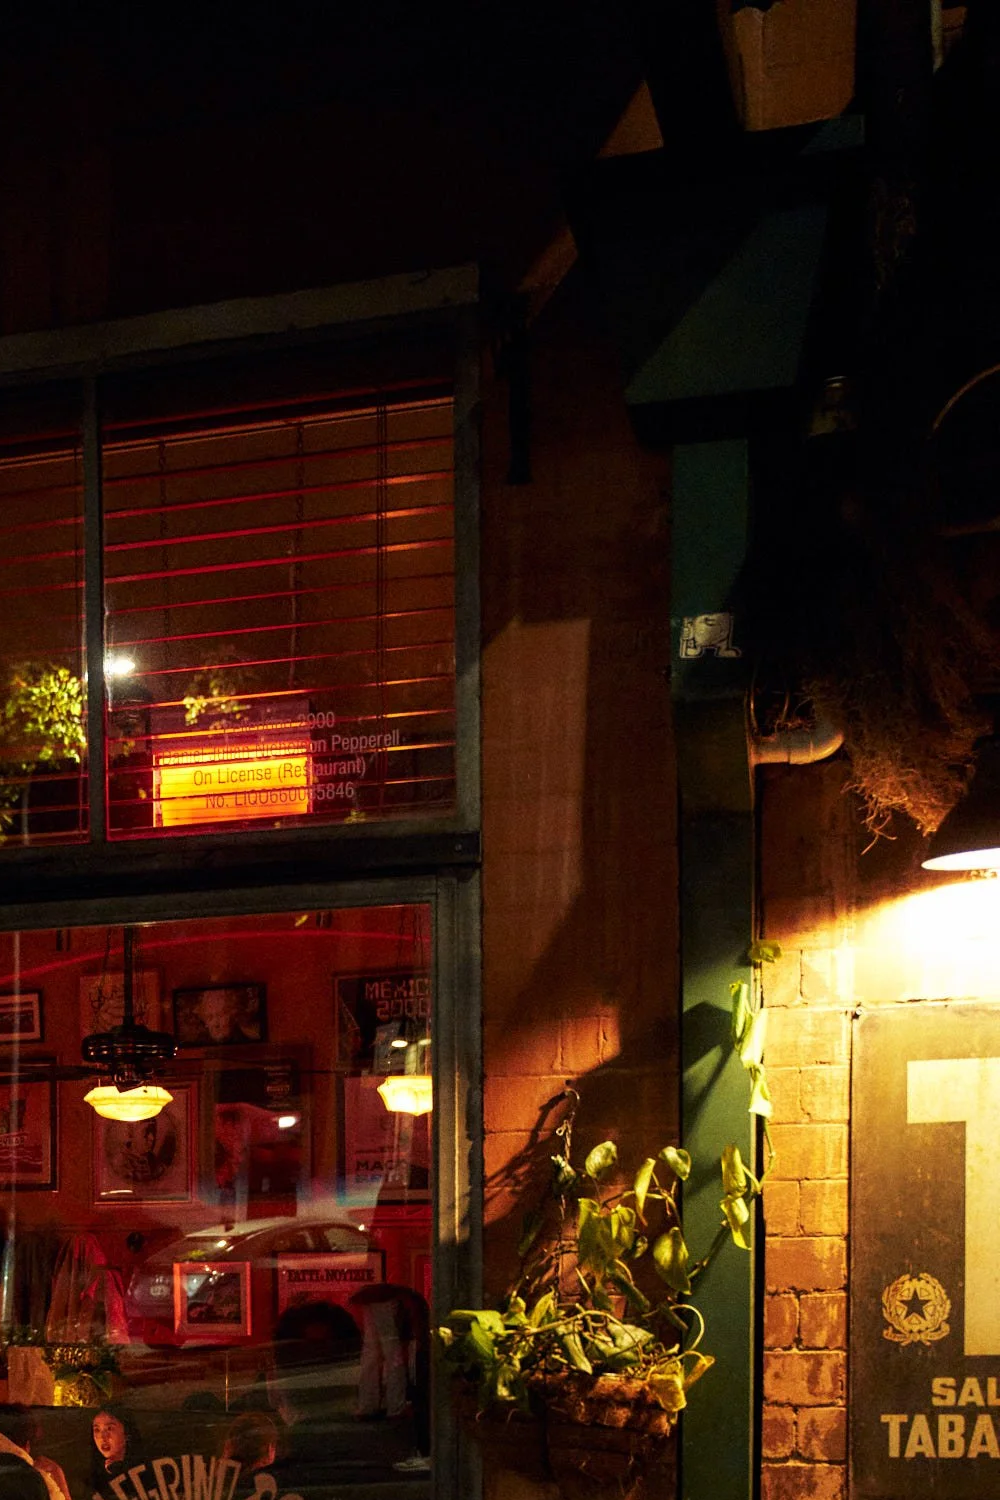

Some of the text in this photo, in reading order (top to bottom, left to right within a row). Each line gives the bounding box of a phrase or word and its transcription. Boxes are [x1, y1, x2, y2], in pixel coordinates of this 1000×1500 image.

[331, 729, 401, 751] Pepperell
[193, 769, 212, 786] On
[218, 766, 272, 784] License
[206, 794, 230, 809] No.
[931, 1376, 1000, 1408] SAL
[880, 1413, 1000, 1459] TABA
